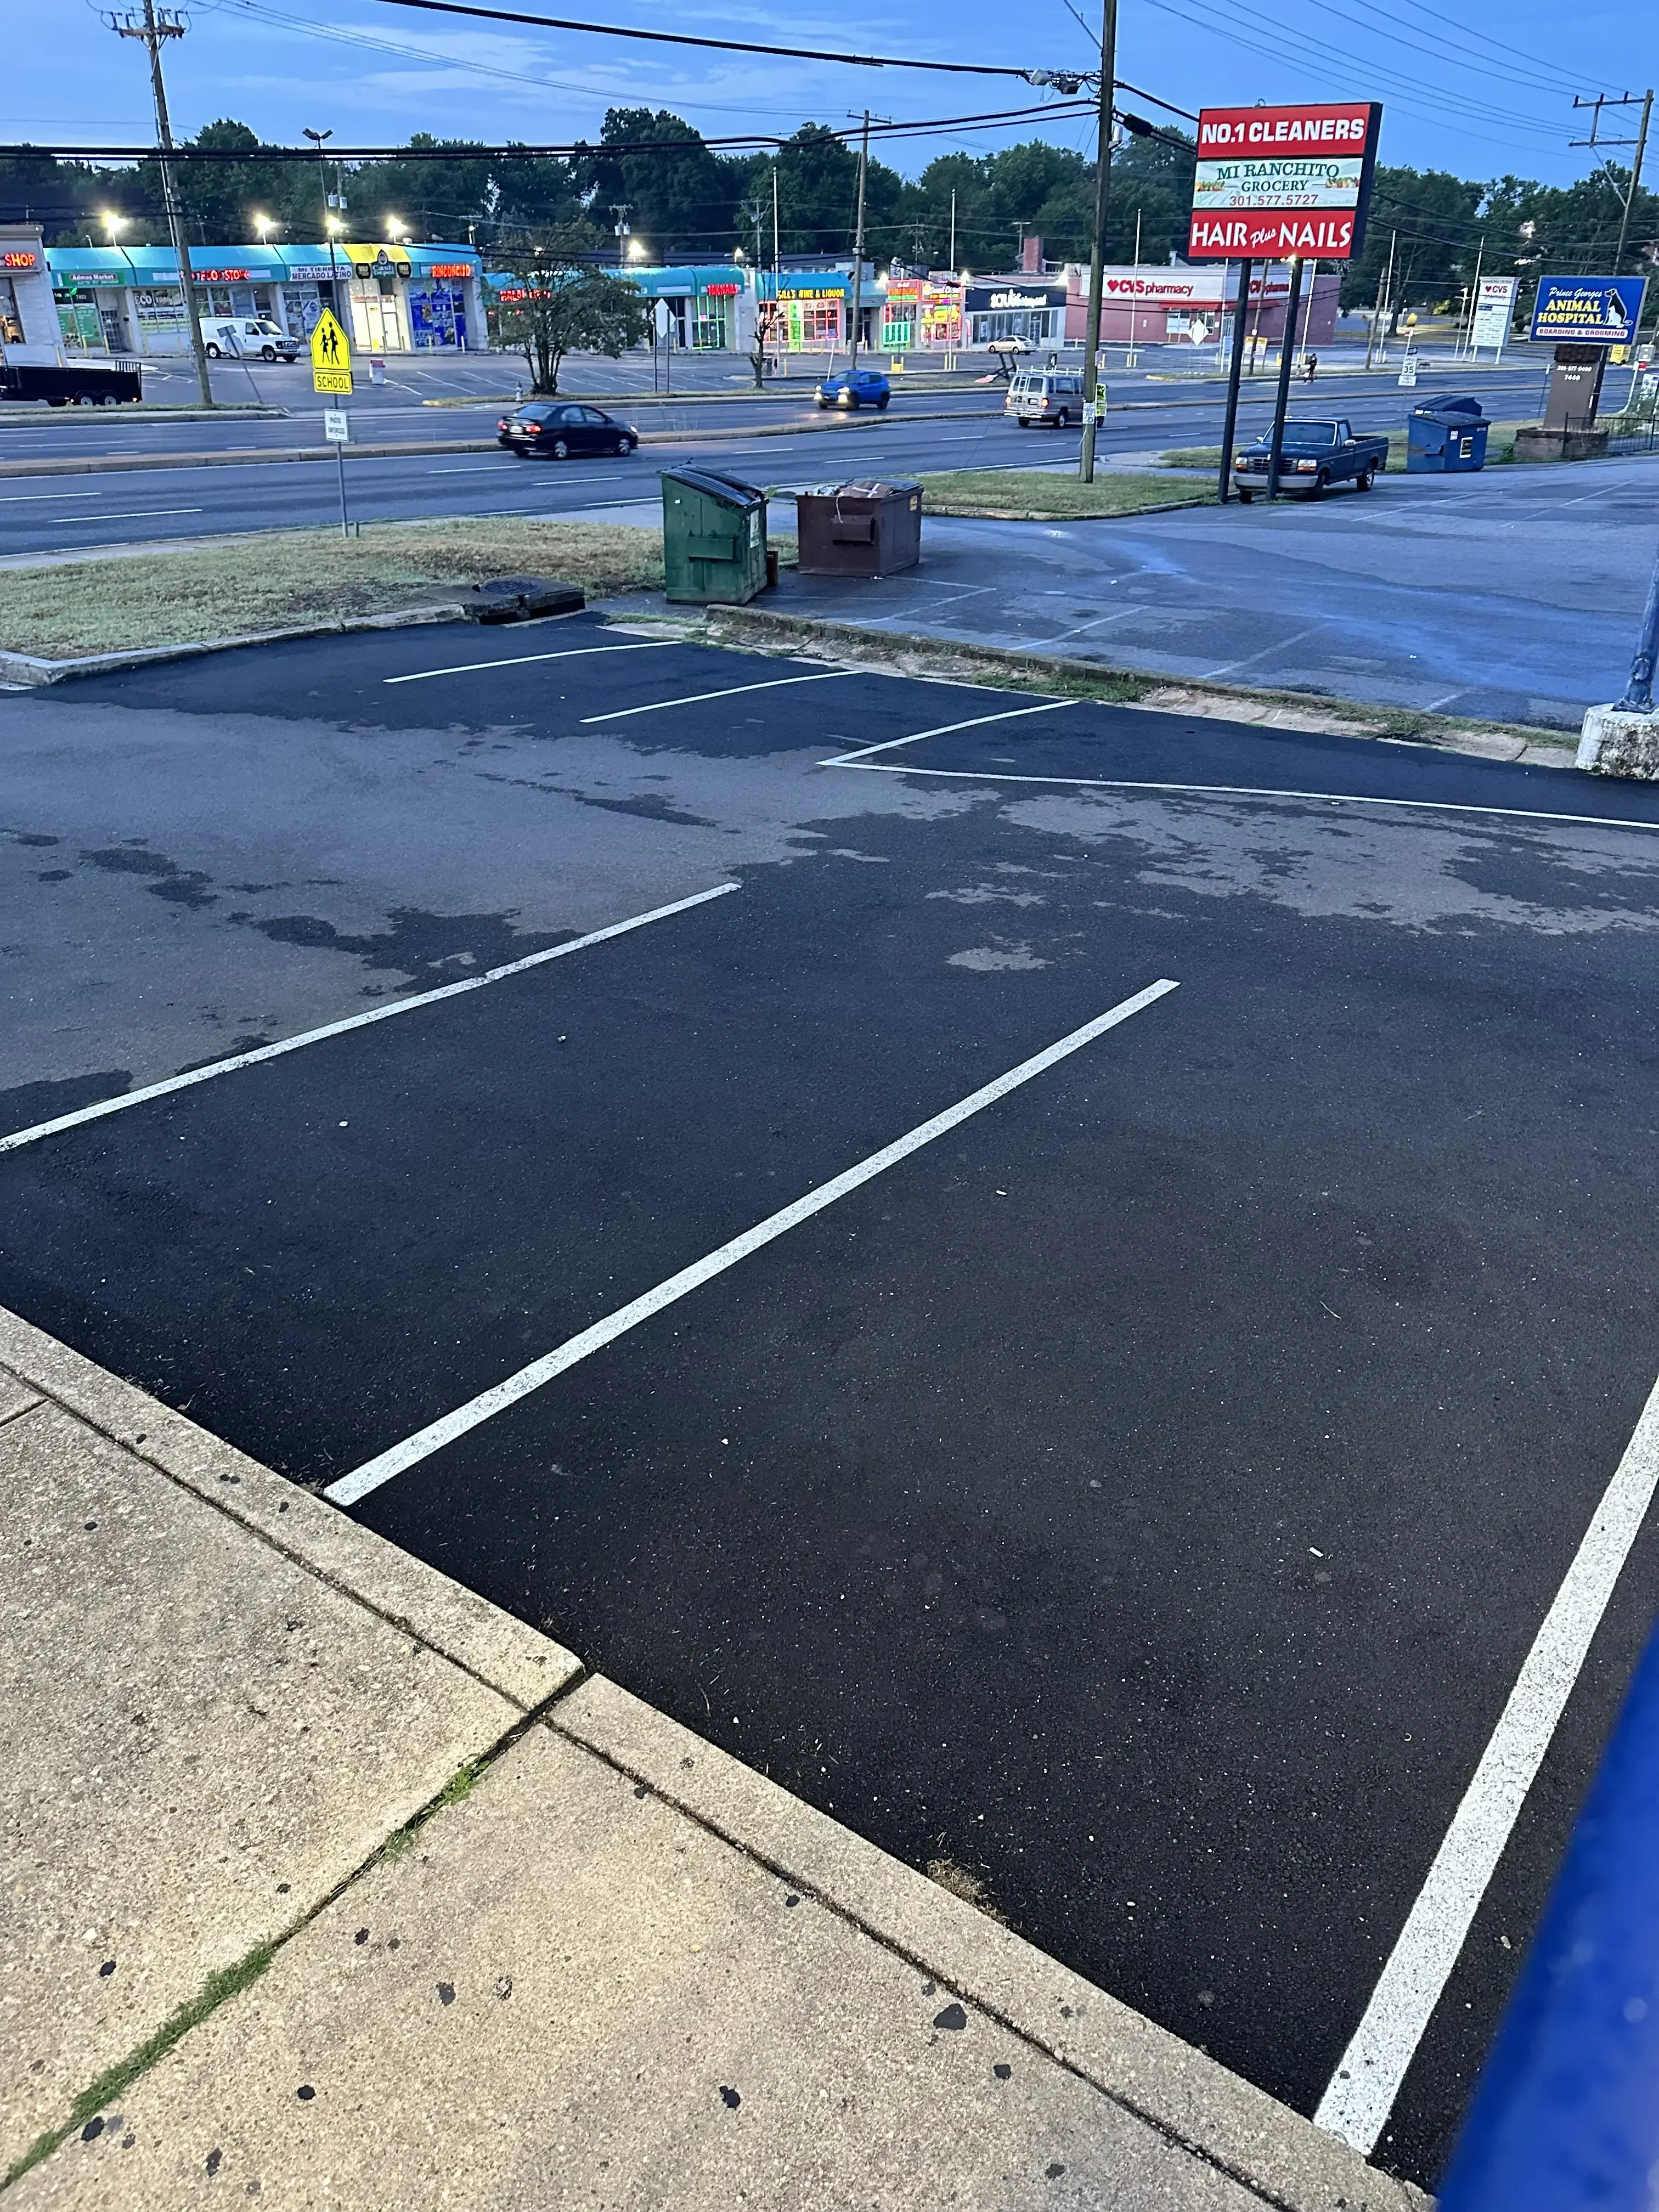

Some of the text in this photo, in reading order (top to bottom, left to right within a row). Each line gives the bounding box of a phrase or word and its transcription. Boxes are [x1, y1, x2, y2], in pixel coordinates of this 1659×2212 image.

[1201, 119, 1365, 144] NO.1 CLEANERS
[1216, 162, 1340, 180] MI RANCHITO
[1242, 180, 1309, 192] GROCERY
[1229, 194, 1319, 206] 301.577.5727
[1190, 222, 1248, 247] HAIR
[1278, 221, 1351, 247] NAILS
[4, 252, 36, 267] SHOP
[822, 288, 844, 298] LIQUOR
[1119, 279, 1194, 297] CVS pharmacy
[1492, 285, 1508, 294] CVS
[1548, 286, 1573, 297] Prince
[134, 295, 153, 304] ECO
[1545, 299, 1601, 312] ANIMAL
[1537, 312, 1604, 325] HOSPITAL
[1403, 365, 1414, 374] 35
[317, 376, 349, 389] SCHOOL
